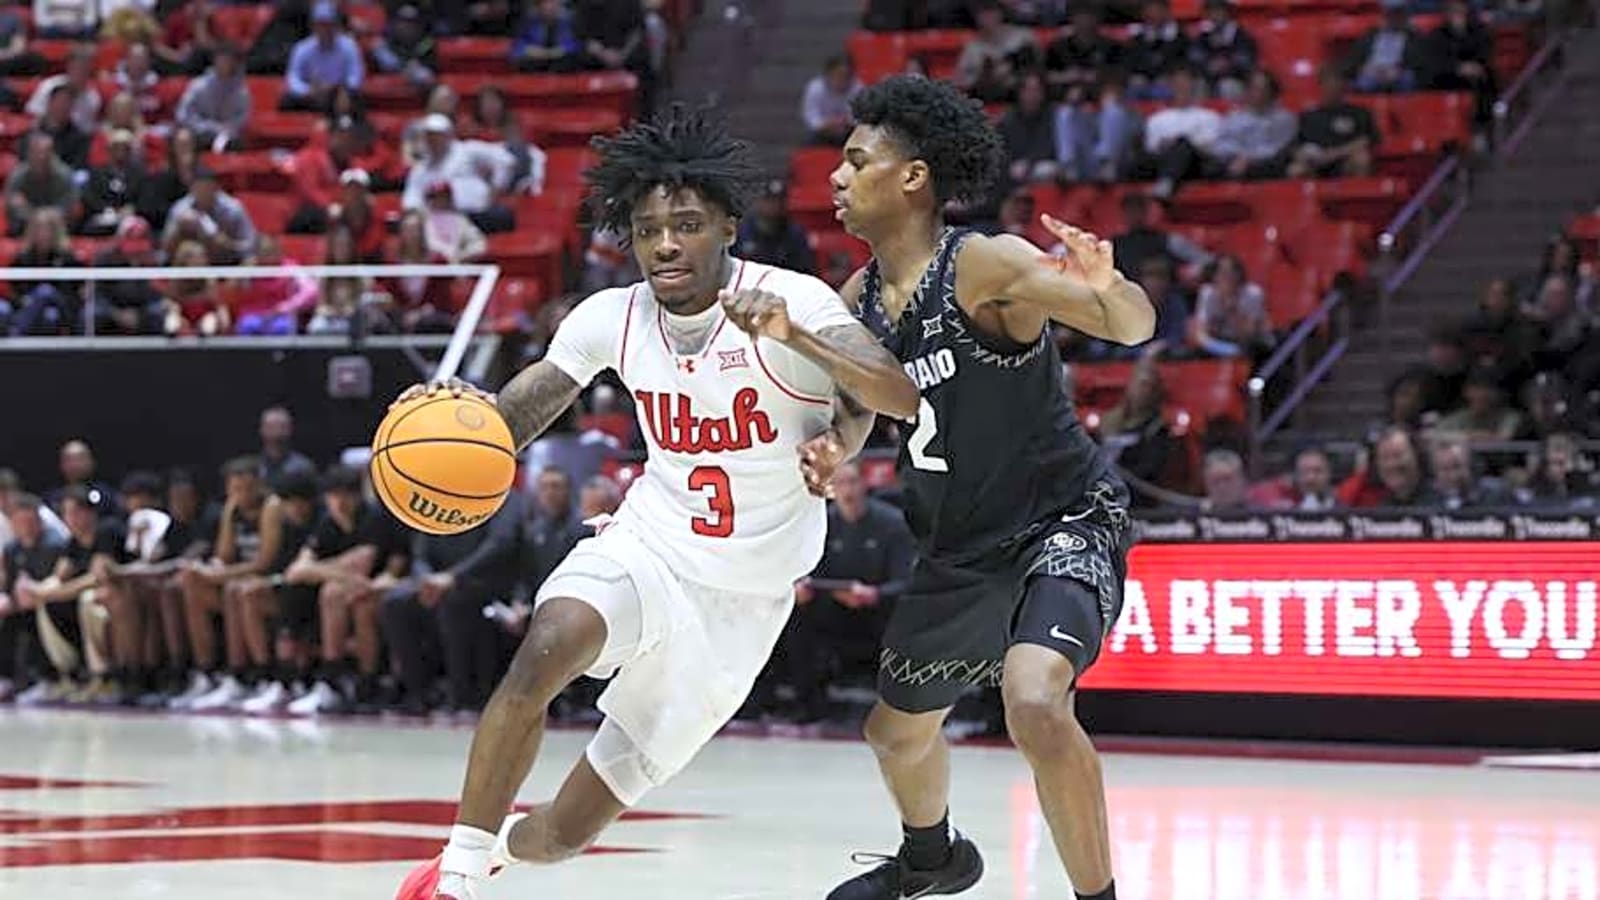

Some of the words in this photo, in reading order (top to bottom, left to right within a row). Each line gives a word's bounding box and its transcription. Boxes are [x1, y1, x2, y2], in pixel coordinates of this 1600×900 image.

[635, 387, 778, 455] Utah
[906, 396, 949, 472] 2
[409, 491, 489, 526] Wilso
[688, 465, 735, 538] 3
[1109, 579, 1158, 654] A
[1169, 579, 1422, 657] BETTER
[1432, 579, 1597, 659] YOU
